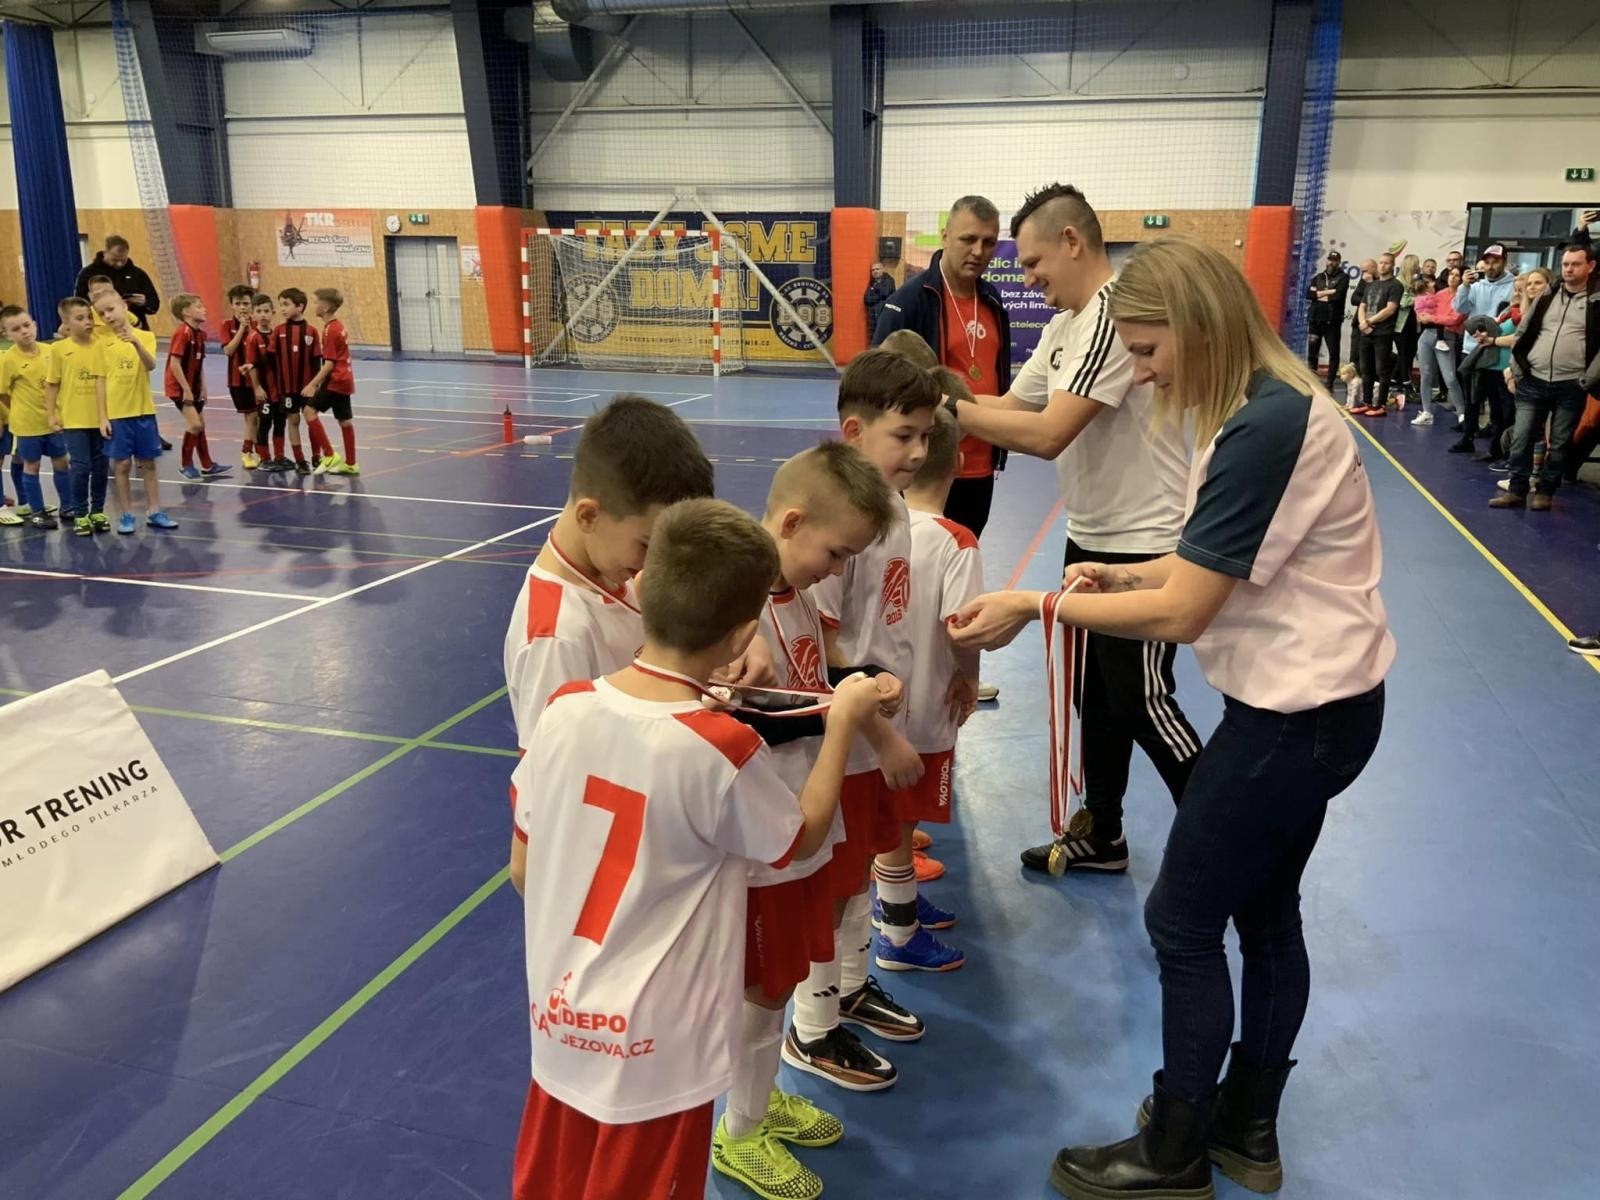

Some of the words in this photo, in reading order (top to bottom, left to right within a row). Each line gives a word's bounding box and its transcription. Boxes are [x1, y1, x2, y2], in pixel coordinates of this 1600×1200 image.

[304, 212, 336, 227] TKR
[629, 267, 760, 313] DOMA!
[1001, 289, 1021, 298] bez
[262, 403, 270, 414] 5
[285, 397, 293, 408] 8
[25, 759, 149, 829] TRENING
[1, 824, 81, 868] MŁODEGO
[89, 785, 158, 823] PIŁKARZA
[572, 774, 647, 946] 7
[562, 1008, 627, 1033] DEPO
